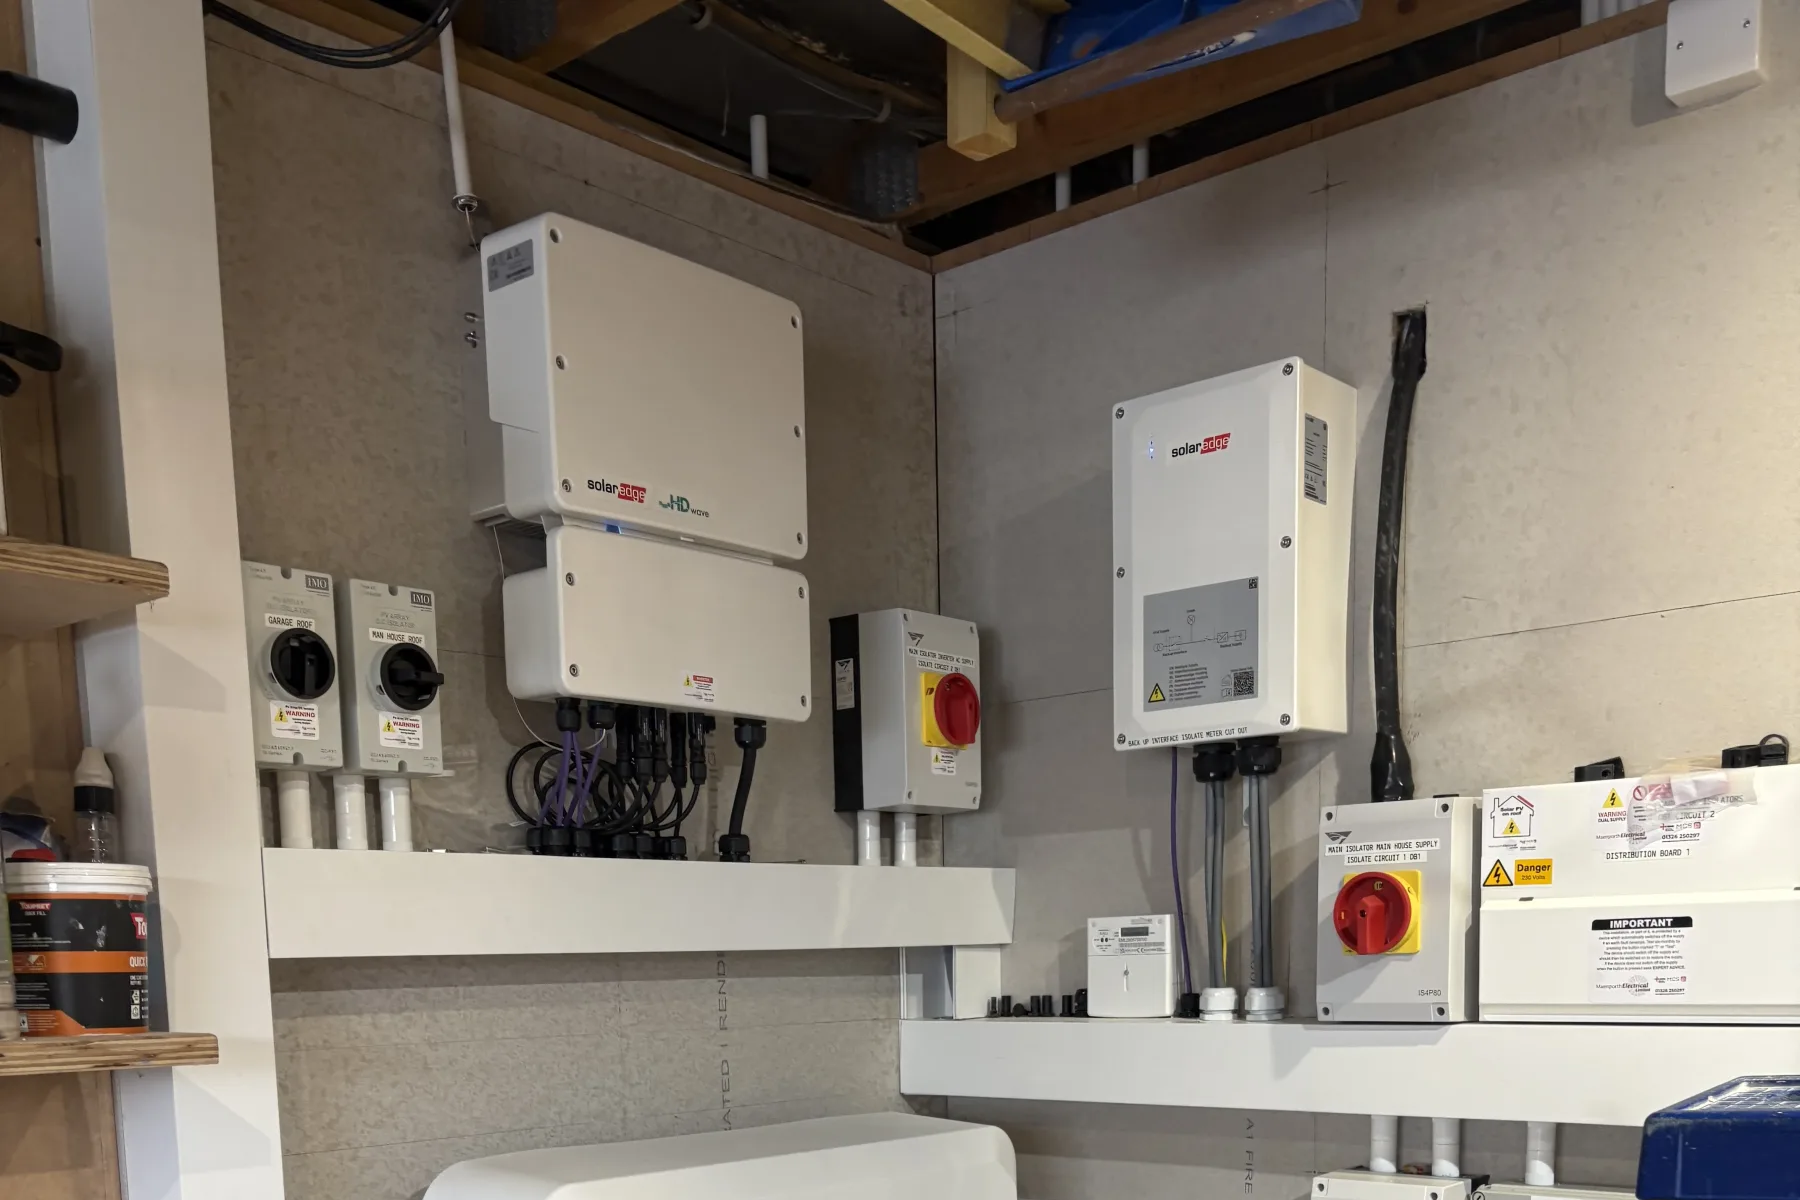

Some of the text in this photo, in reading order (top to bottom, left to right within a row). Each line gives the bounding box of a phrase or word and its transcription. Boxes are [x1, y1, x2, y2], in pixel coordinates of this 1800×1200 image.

[1172, 434, 1230, 457] solaredge
[587, 479, 646, 503] solaredge
[669, 494, 709, 518] HD wave
[307, 577, 328, 589] IMO
[413, 593, 430, 604] IMO
[268, 616, 313, 628] GARAGE ROOF
[386, 632, 405, 642] HOUSE
[408, 635, 423, 644] ROOF
[285, 710, 316, 718] WARNING
[1152, 735, 1178, 744] INTERFACE
[1182, 732, 1204, 740] ISOLATE
[1206, 730, 1222, 738] METER
[1224, 728, 1235, 736] CUT
[1238, 726, 1248, 734] OUT
[1710, 810, 1715, 818] 2
[1346, 844, 1374, 852] ISOLATOR
[1394, 842, 1412, 850] HOUSE
[1416, 840, 1438, 848] SUPPLY
[1347, 856, 1372, 864] ISOLATE
[1374, 854, 1400, 862] CIRCUIT
[1606, 850, 1656, 860] DISTRIBUTION
[1660, 849, 1682, 857] BOARD
[1517, 864, 1551, 873] Danger
[1610, 918, 1673, 928] IMPORTANT
[721, 1060, 732, 1131] ATED
[1246, 1118, 1254, 1140] A1
[1244, 1150, 1254, 1194] FIRE
